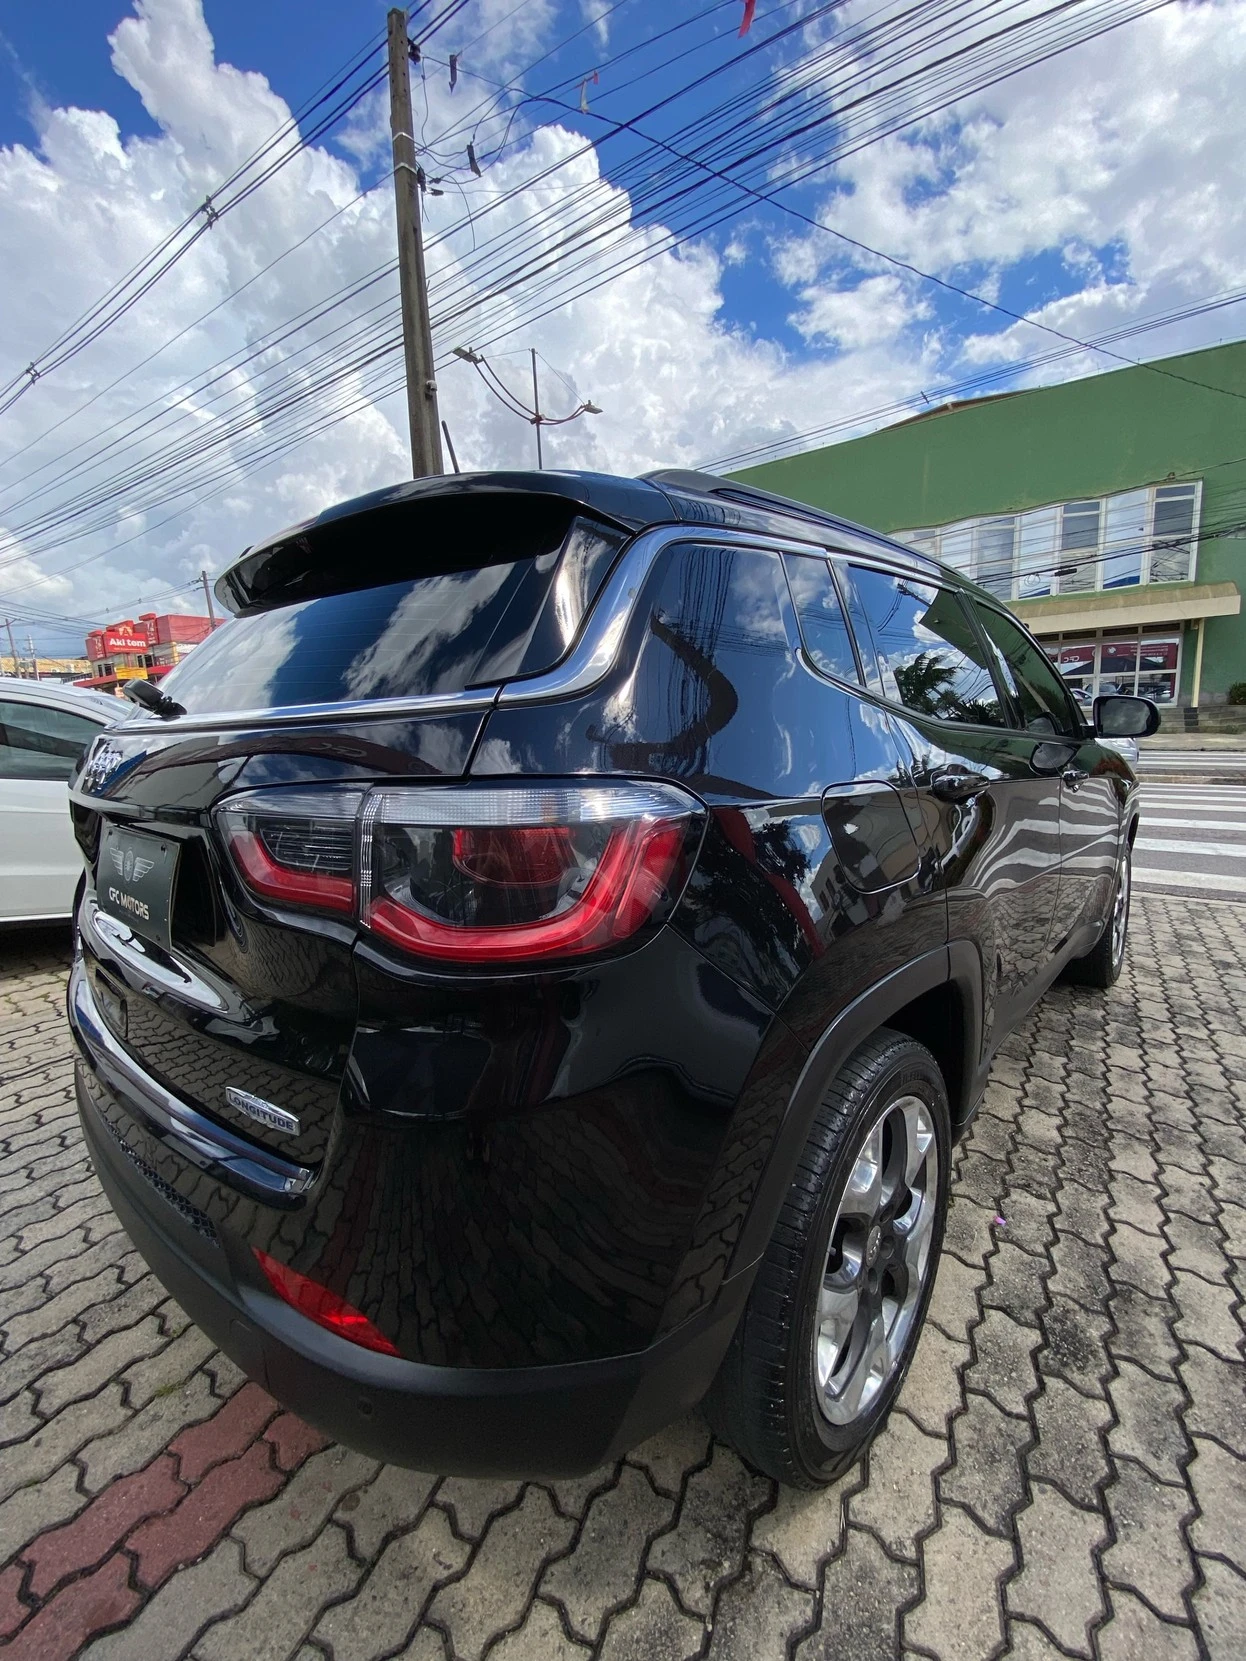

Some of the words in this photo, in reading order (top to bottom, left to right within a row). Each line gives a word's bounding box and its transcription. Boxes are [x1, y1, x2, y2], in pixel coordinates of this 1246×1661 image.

[109, 638, 125, 646] Aki
[120, 892, 150, 920] MOTORS
[228, 1092, 295, 1131] LONGITUDE
